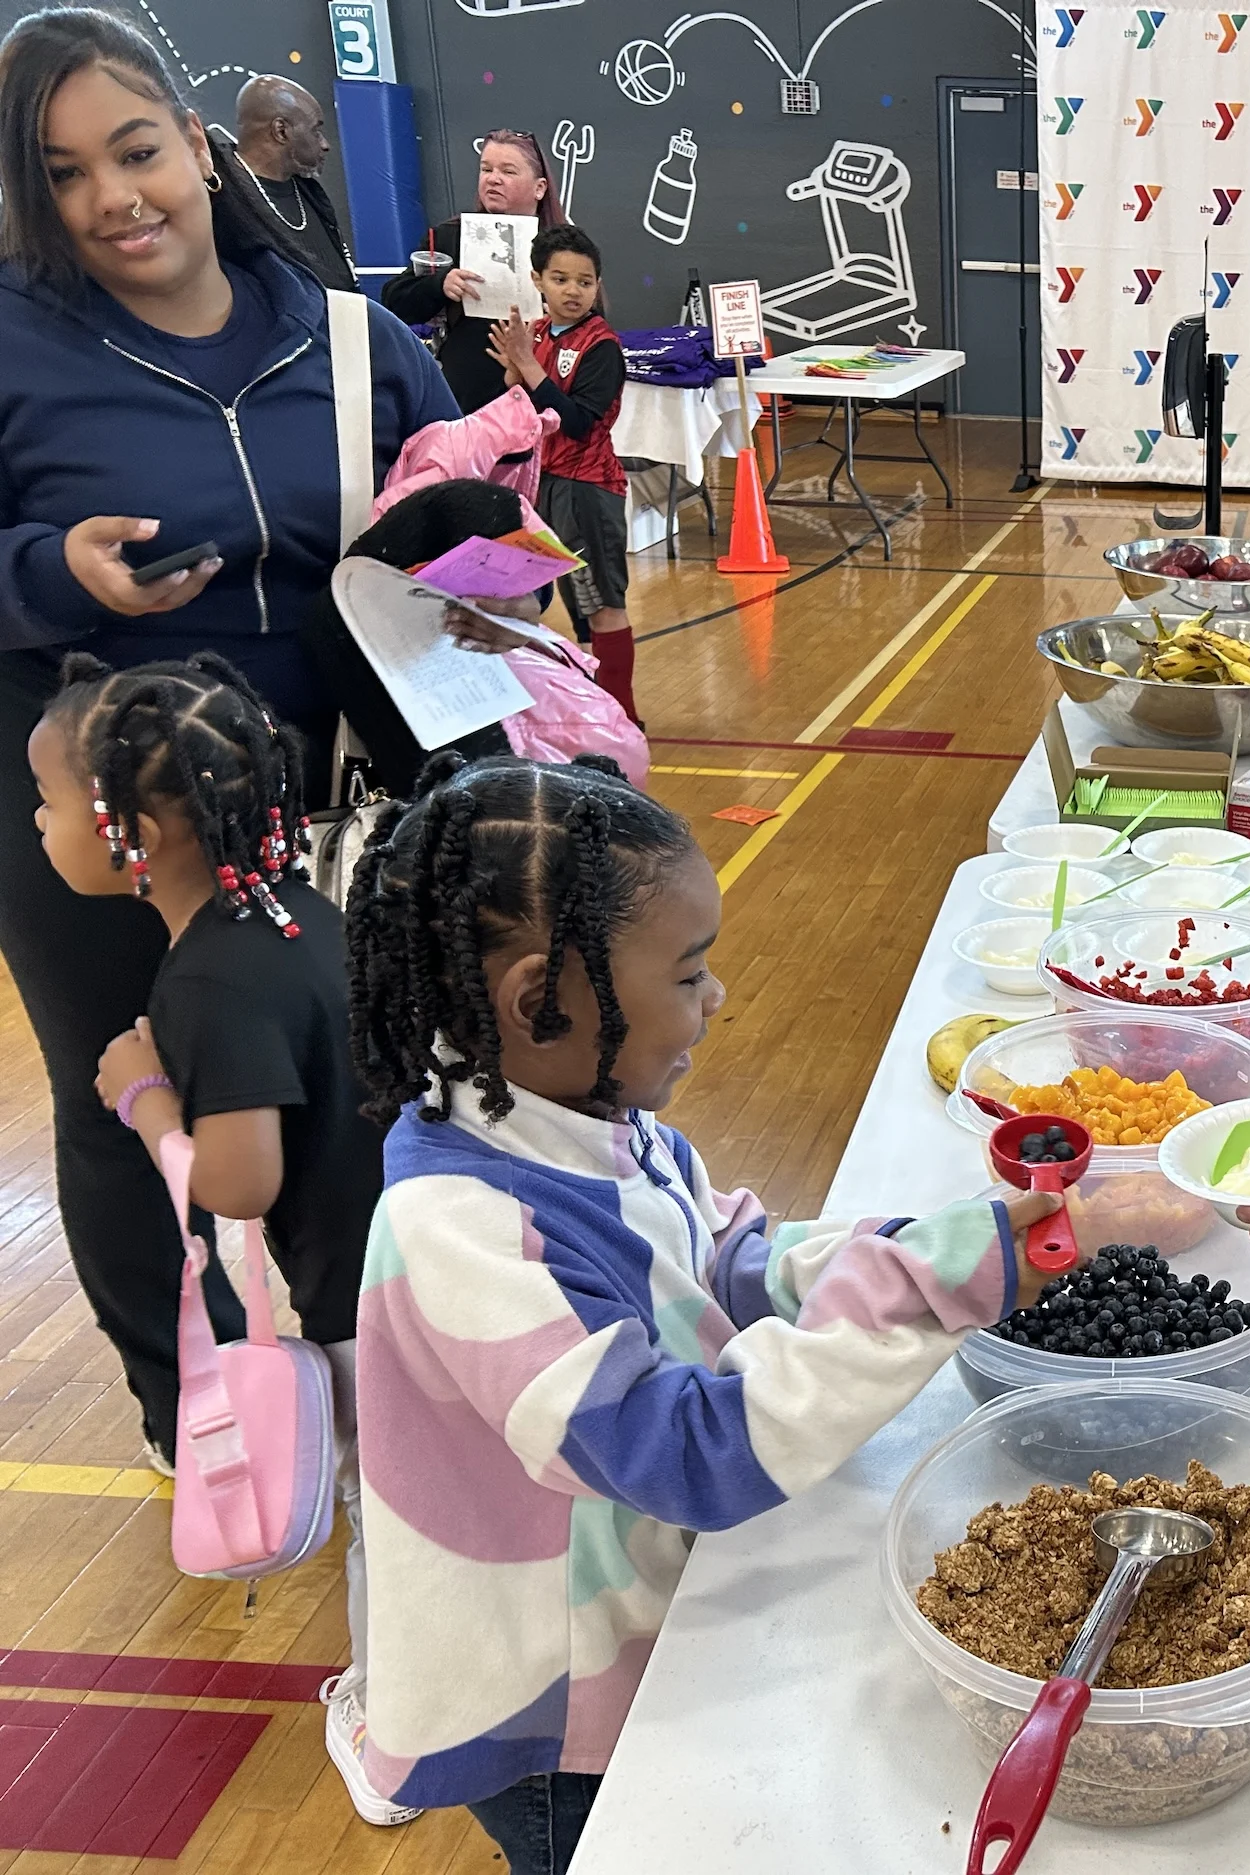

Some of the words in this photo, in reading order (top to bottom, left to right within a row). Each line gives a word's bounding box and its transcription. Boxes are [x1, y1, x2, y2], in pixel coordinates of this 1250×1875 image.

[335, 6, 370, 18] COURT
[1043, 27, 1056, 35] the
[1124, 29, 1137, 38] the
[1205, 32, 1218, 40] the
[338, 20, 374, 74] 3
[1043, 114, 1056, 123] the
[1124, 117, 1136, 125] the
[1202, 120, 1216, 128] the
[1044, 200, 1056, 208] the
[1200, 205, 1214, 213] the
[721, 290, 749, 301] FINISH
[727, 301, 746, 312] LINE
